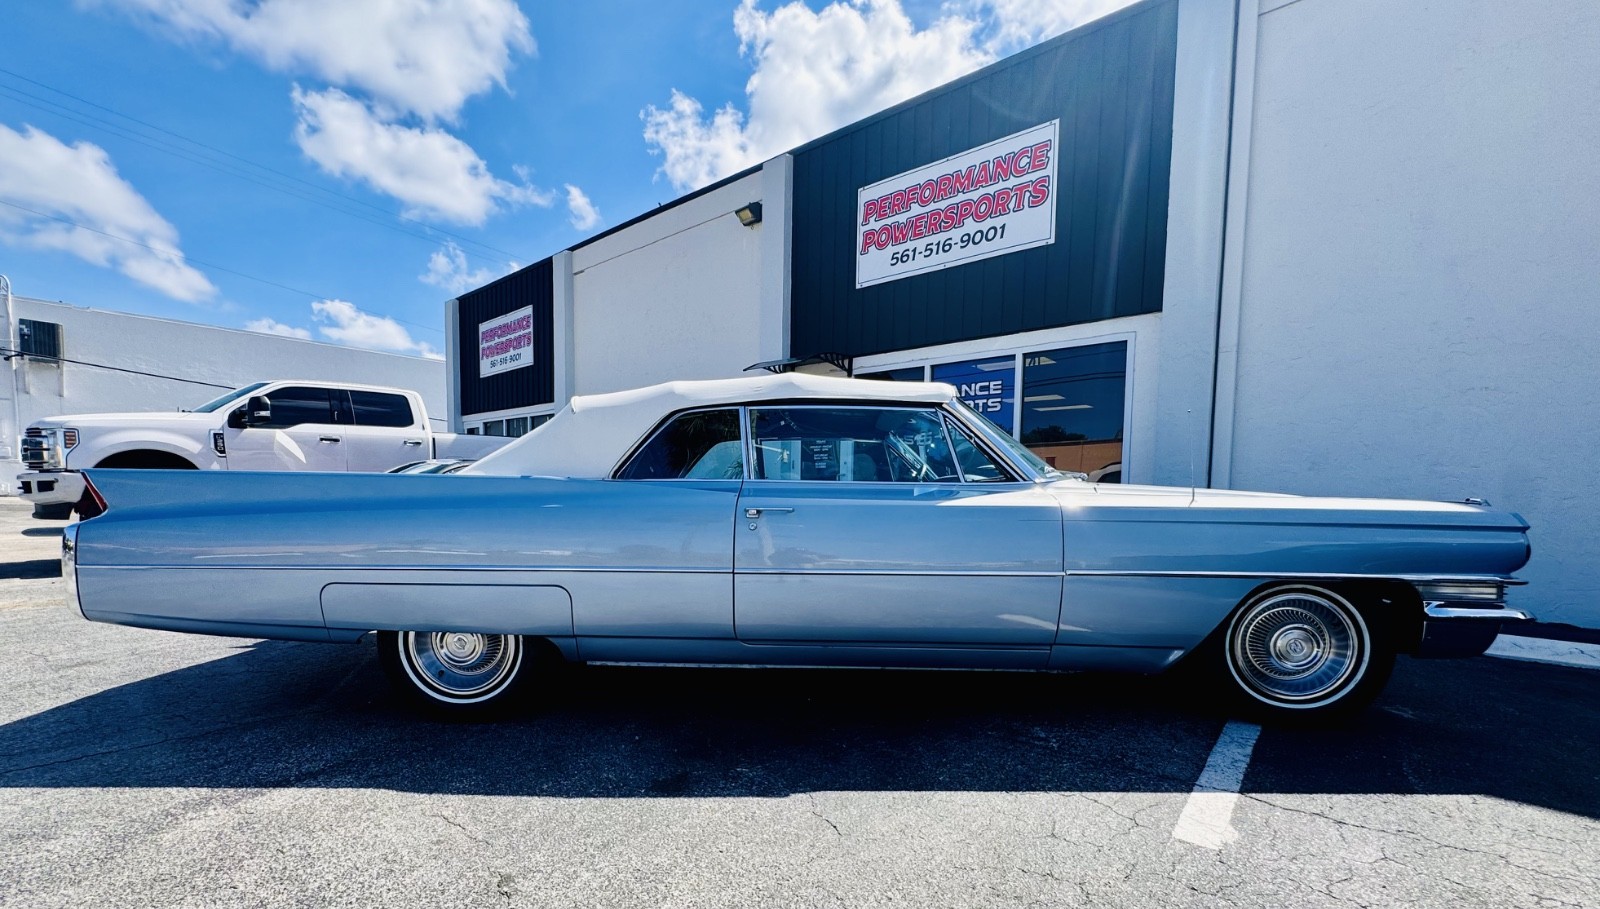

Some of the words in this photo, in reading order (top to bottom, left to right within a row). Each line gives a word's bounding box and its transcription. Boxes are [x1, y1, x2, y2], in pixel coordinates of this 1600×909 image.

[861, 139, 1052, 226] PERFORMANCE
[860, 175, 1050, 255] POWERSPORTS
[890, 223, 1006, 266] 561-516-9001
[481, 314, 531, 345] PERFORMANCE
[481, 331, 532, 360] POWERSPORTS
[955, 381, 1002, 397] NCE
